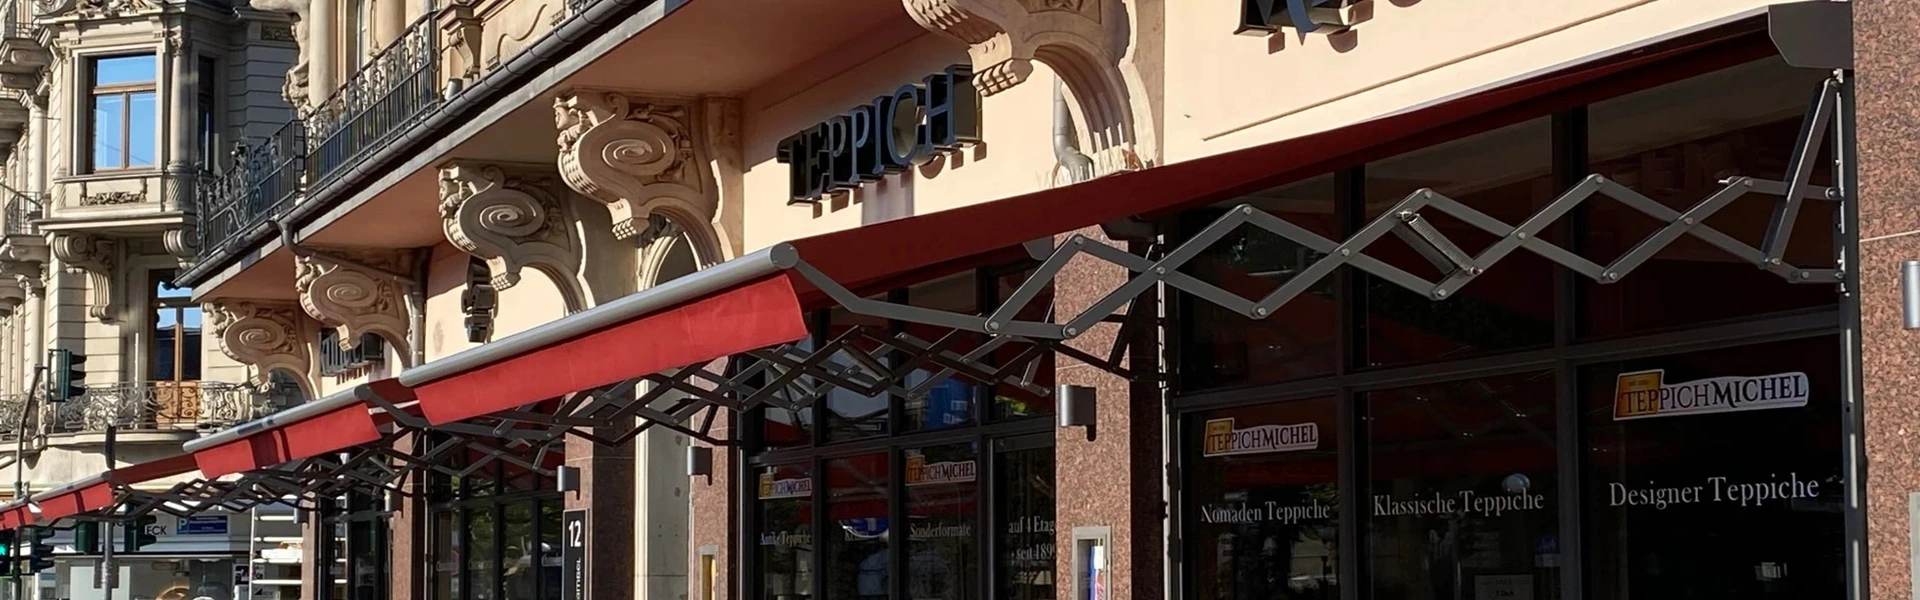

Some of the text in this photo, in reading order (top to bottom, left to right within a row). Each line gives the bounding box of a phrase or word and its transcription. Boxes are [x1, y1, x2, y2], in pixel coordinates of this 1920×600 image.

[777, 65, 975, 206] TEPPICH
[1619, 374, 1807, 414] TEPPICHMICHEL
[1206, 425, 1317, 452] TEPPICHMICHEL
[907, 460, 976, 484] TEPPICHMICHEL
[1373, 488, 1545, 517] Klassische Teppiche
[1609, 471, 1820, 510] Designer Teppiche
[1008, 516, 1025, 534] auf
[1200, 498, 1331, 525] Nomaden Teppiche
[568, 520, 582, 548] 12
[908, 522, 972, 539] Sonderformate
